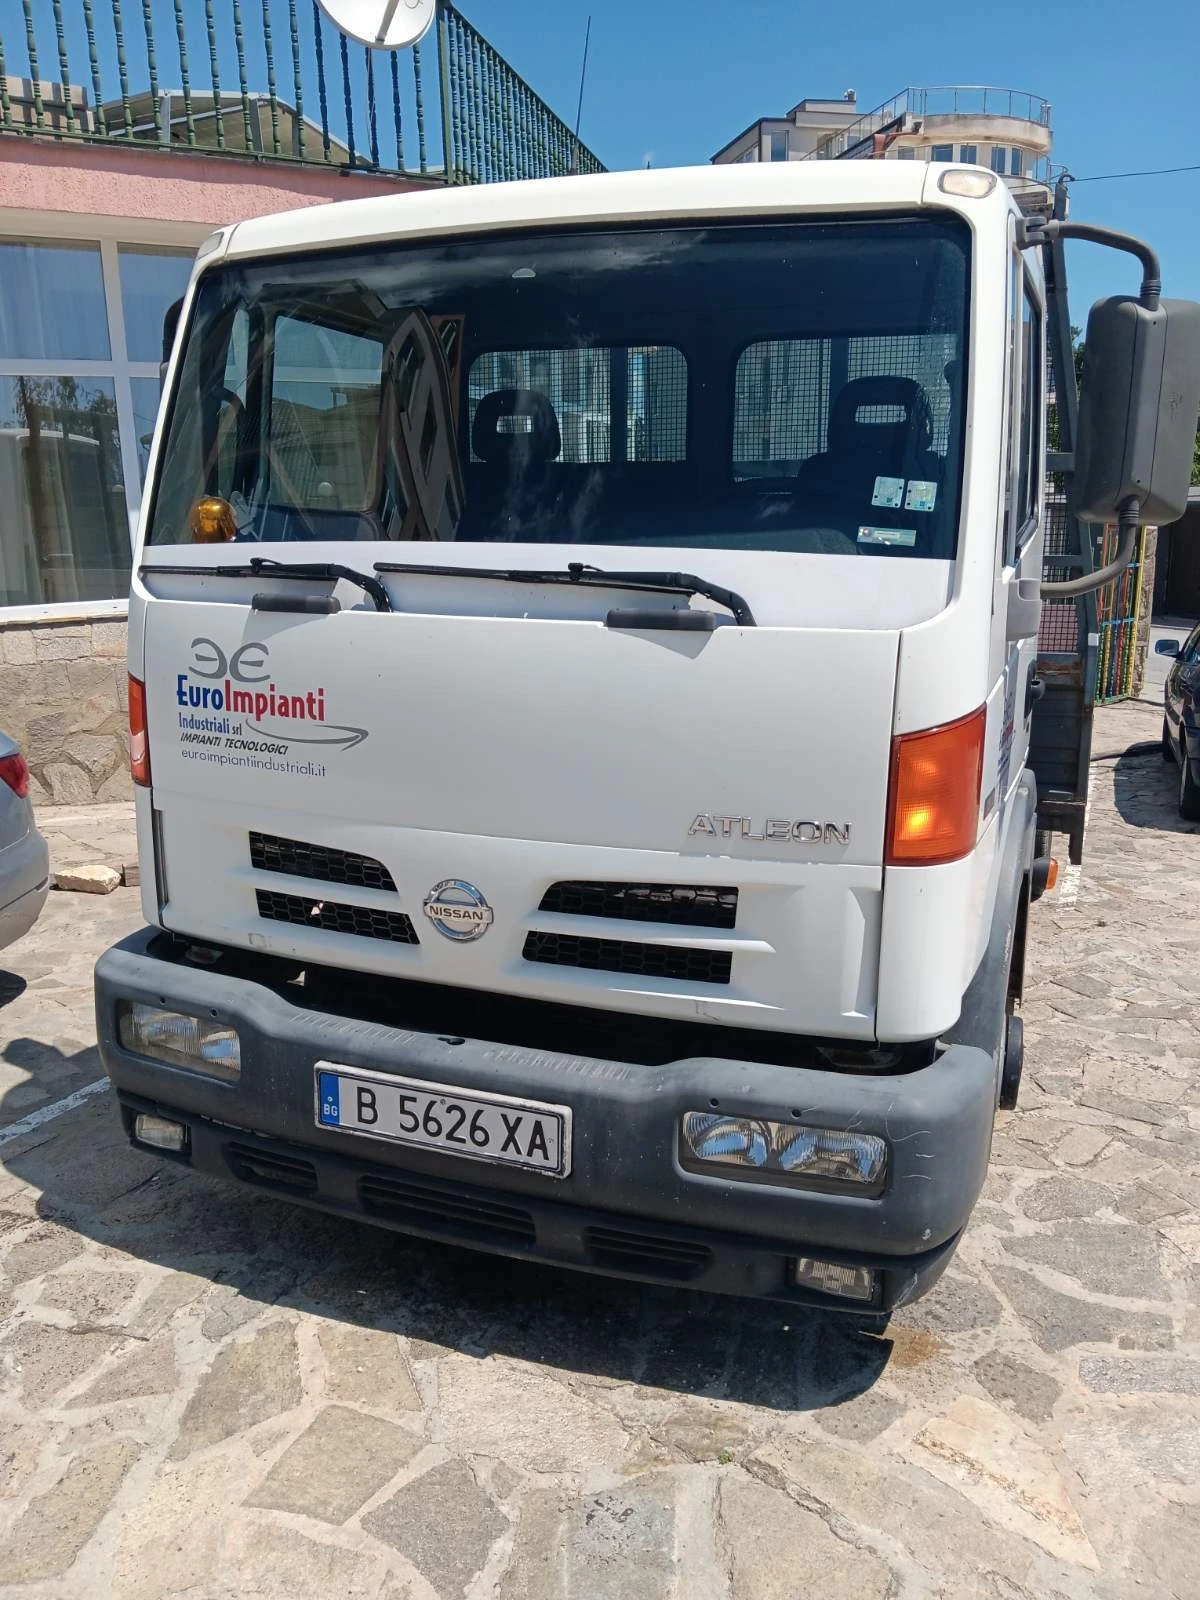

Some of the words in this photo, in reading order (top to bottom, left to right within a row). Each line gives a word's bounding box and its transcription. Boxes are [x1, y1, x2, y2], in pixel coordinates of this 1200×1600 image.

[176, 674, 325, 722] EuroImpianti
[178, 712, 230, 735] Industriali
[231, 723, 242, 736] srl
[180, 732, 221, 747] IMPIANTI
[224, 738, 289, 756] TECNOLOGICI
[181, 749, 326, 777] euroimpiantiindustriali.it
[687, 813, 853, 846] ATLEON
[429, 905, 484, 921] NISSAN
[323, 1103, 338, 1117] BG
[356, 1086, 379, 1125] B
[399, 1095, 490, 1148] 5626
[500, 1113, 550, 1161] XA
